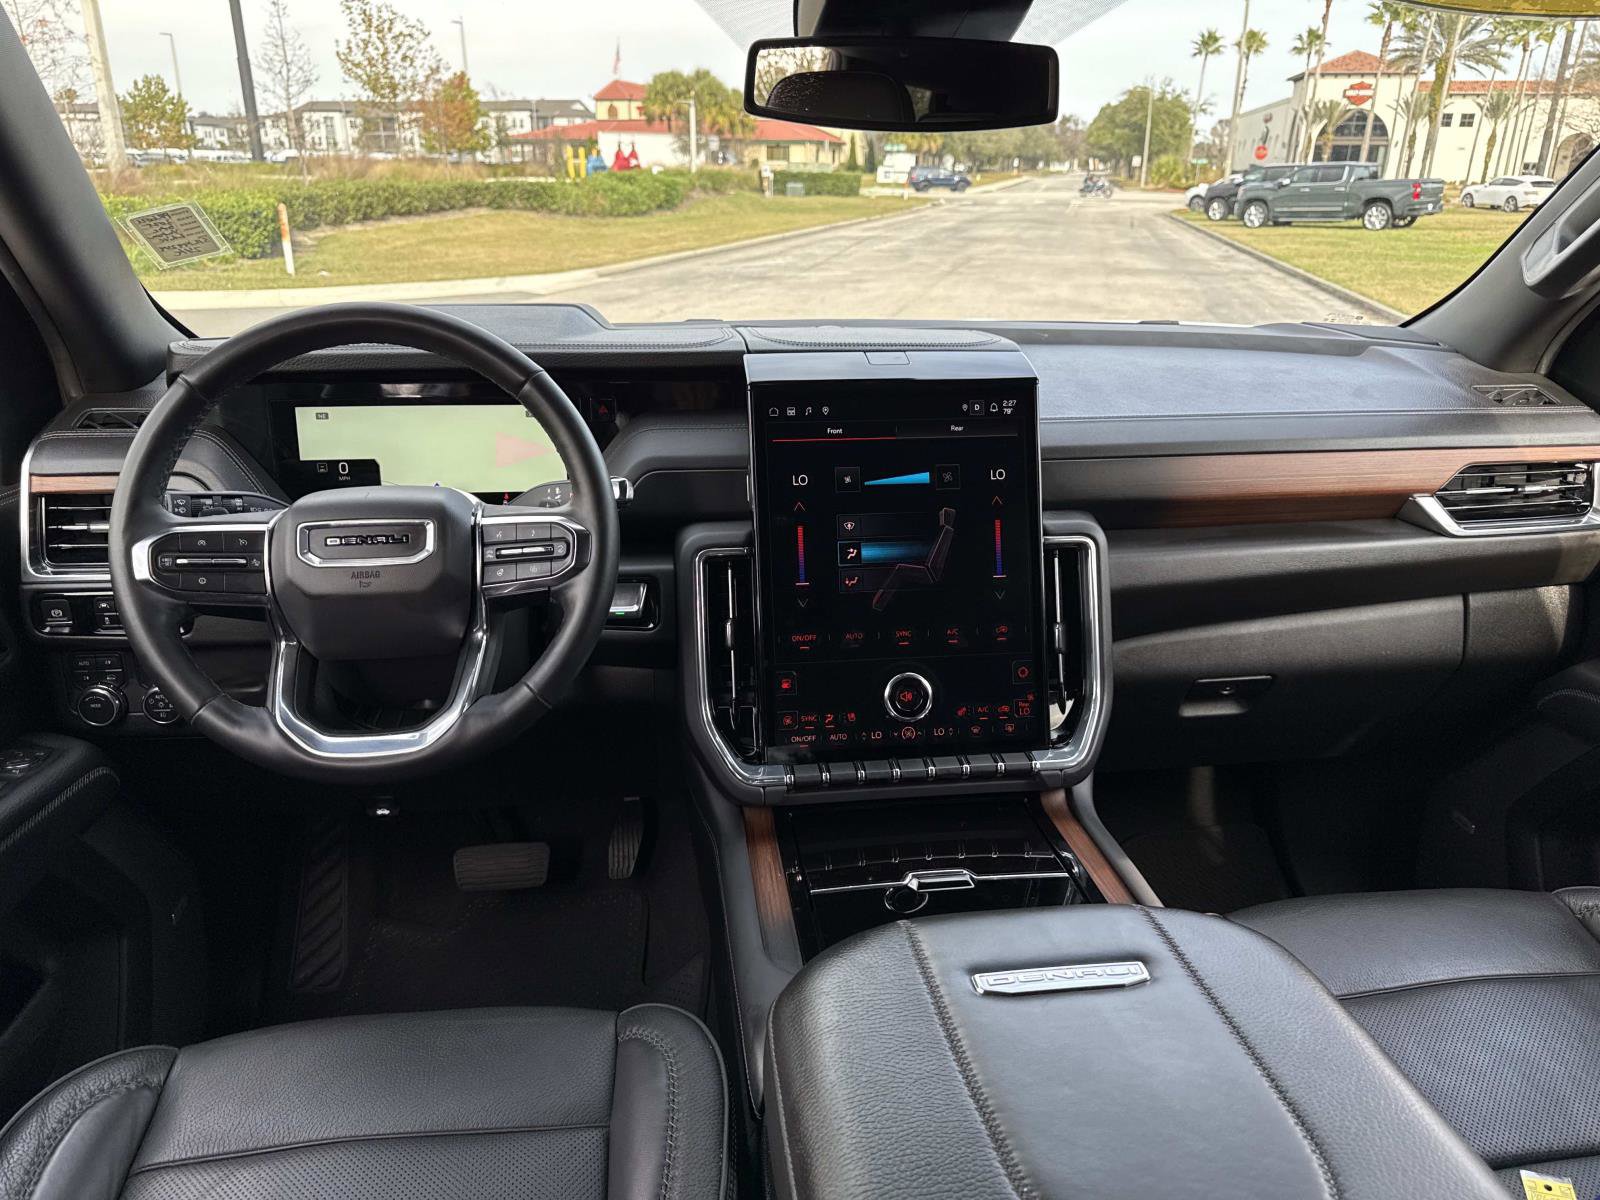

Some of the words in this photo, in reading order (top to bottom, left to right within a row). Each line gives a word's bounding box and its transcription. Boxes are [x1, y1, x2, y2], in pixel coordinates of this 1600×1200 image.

[827, 427, 843, 435] Front
[338, 462, 349, 474] 0
[990, 469, 1006, 481] LO
[792, 474, 809, 486] LO
[324, 534, 411, 547] DENALI
[351, 570, 381, 580] AIRBAG
[845, 631, 864, 640] AUTO
[895, 629, 912, 638] SYNC
[791, 634, 817, 643] ON/OFF
[1019, 707, 1032, 716] LO
[800, 714, 817, 723] SYNC
[870, 731, 883, 740] LO
[934, 727, 946, 736] LO
[790, 734, 817, 743] ON/OFF
[829, 733, 849, 741] AUTO
[986, 964, 1140, 986] DENALI
